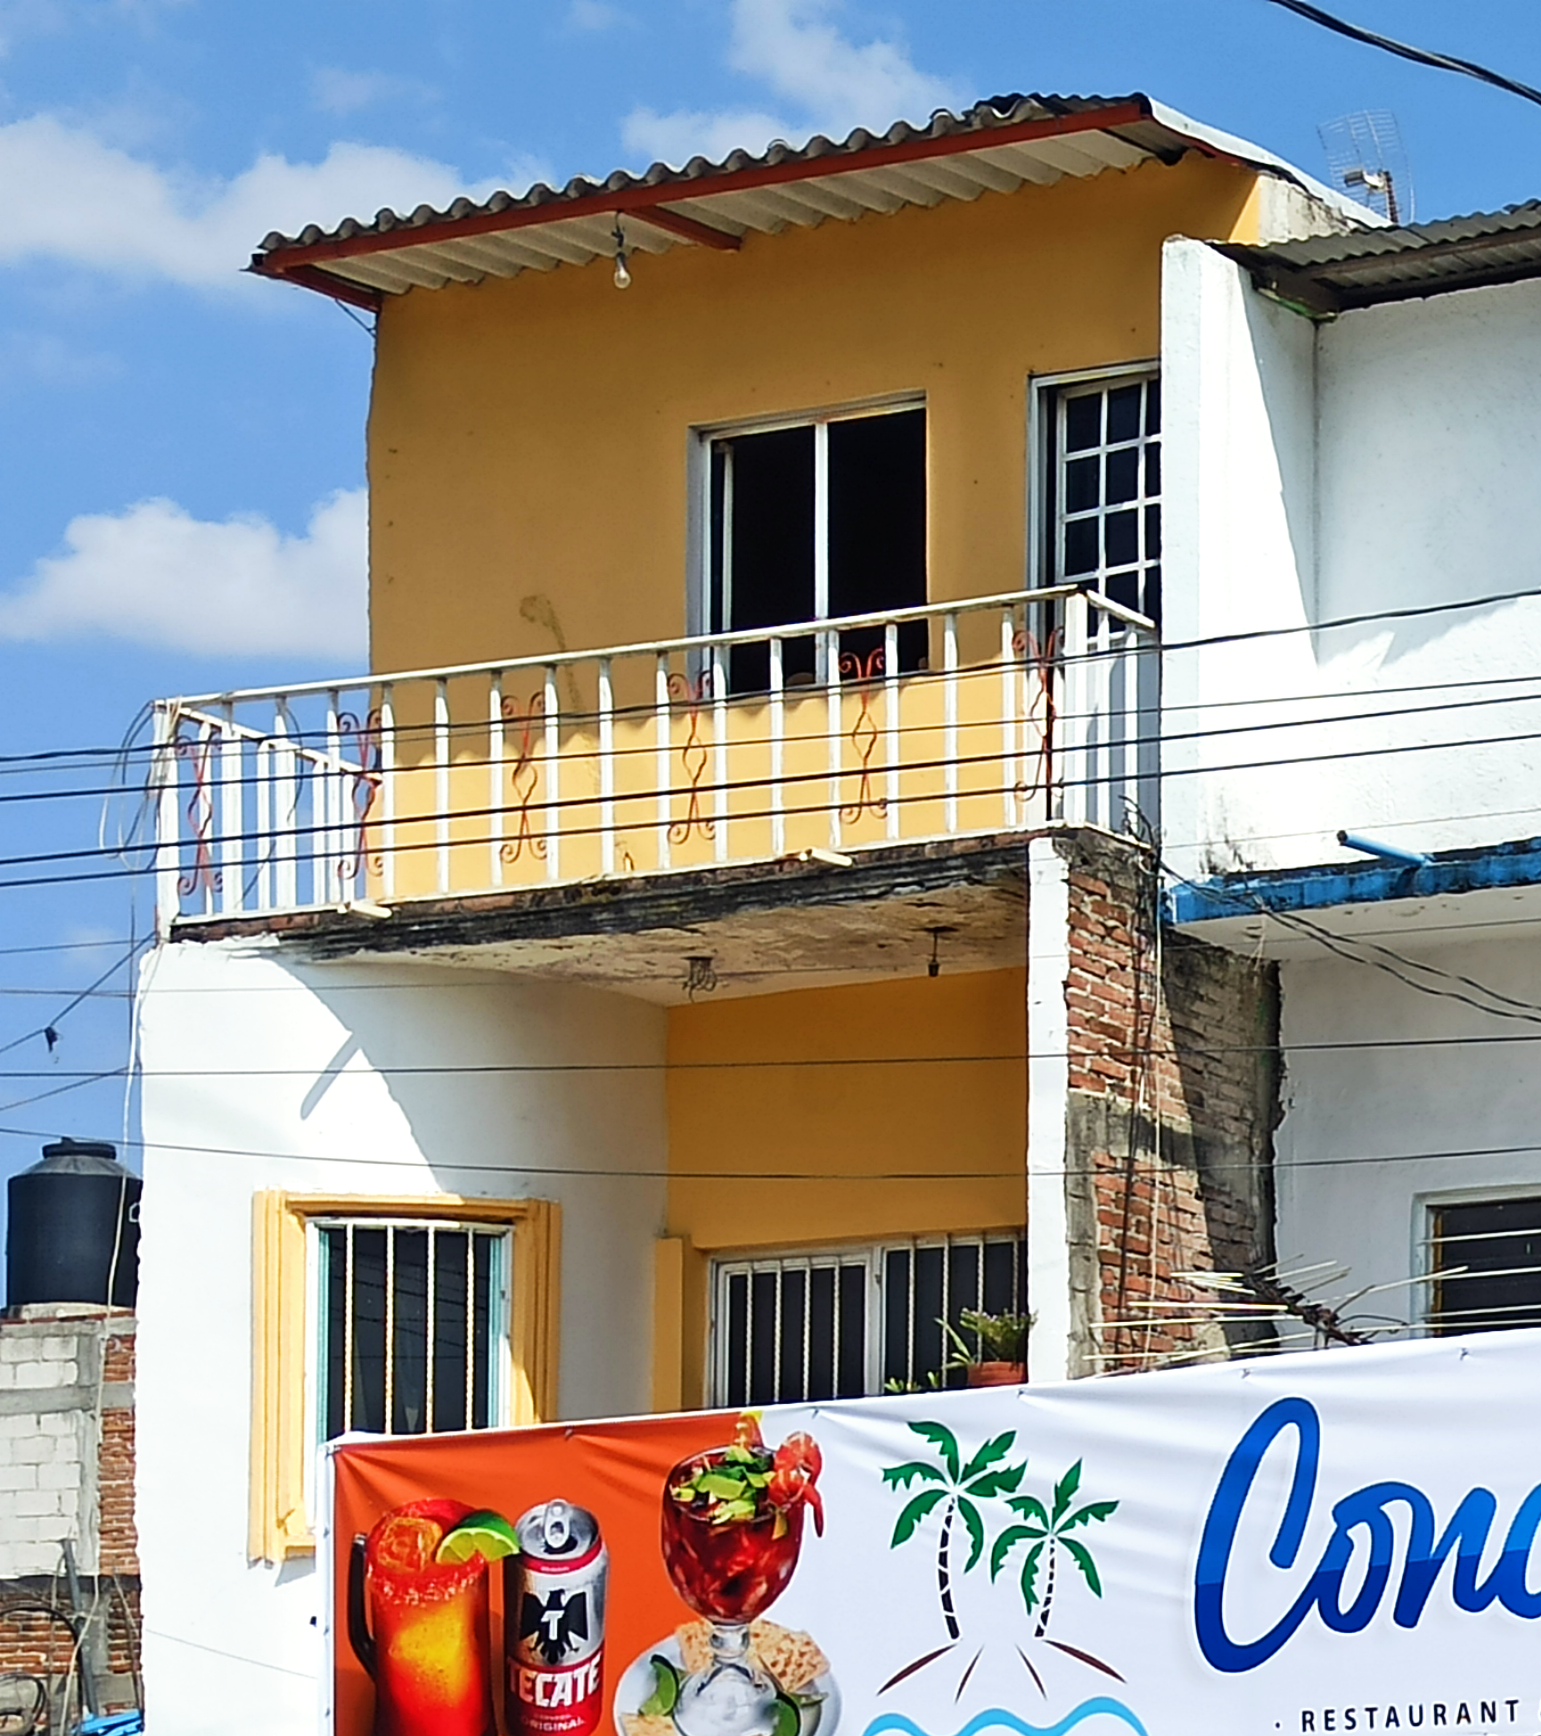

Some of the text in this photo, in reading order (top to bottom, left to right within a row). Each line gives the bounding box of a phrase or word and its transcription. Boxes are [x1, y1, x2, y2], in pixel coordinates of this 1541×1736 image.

[508, 1651, 603, 1708] TECATE
[521, 1716, 586, 1732] ORIGINAL
[1301, 1699, 1520, 1733] RESTAURANT
